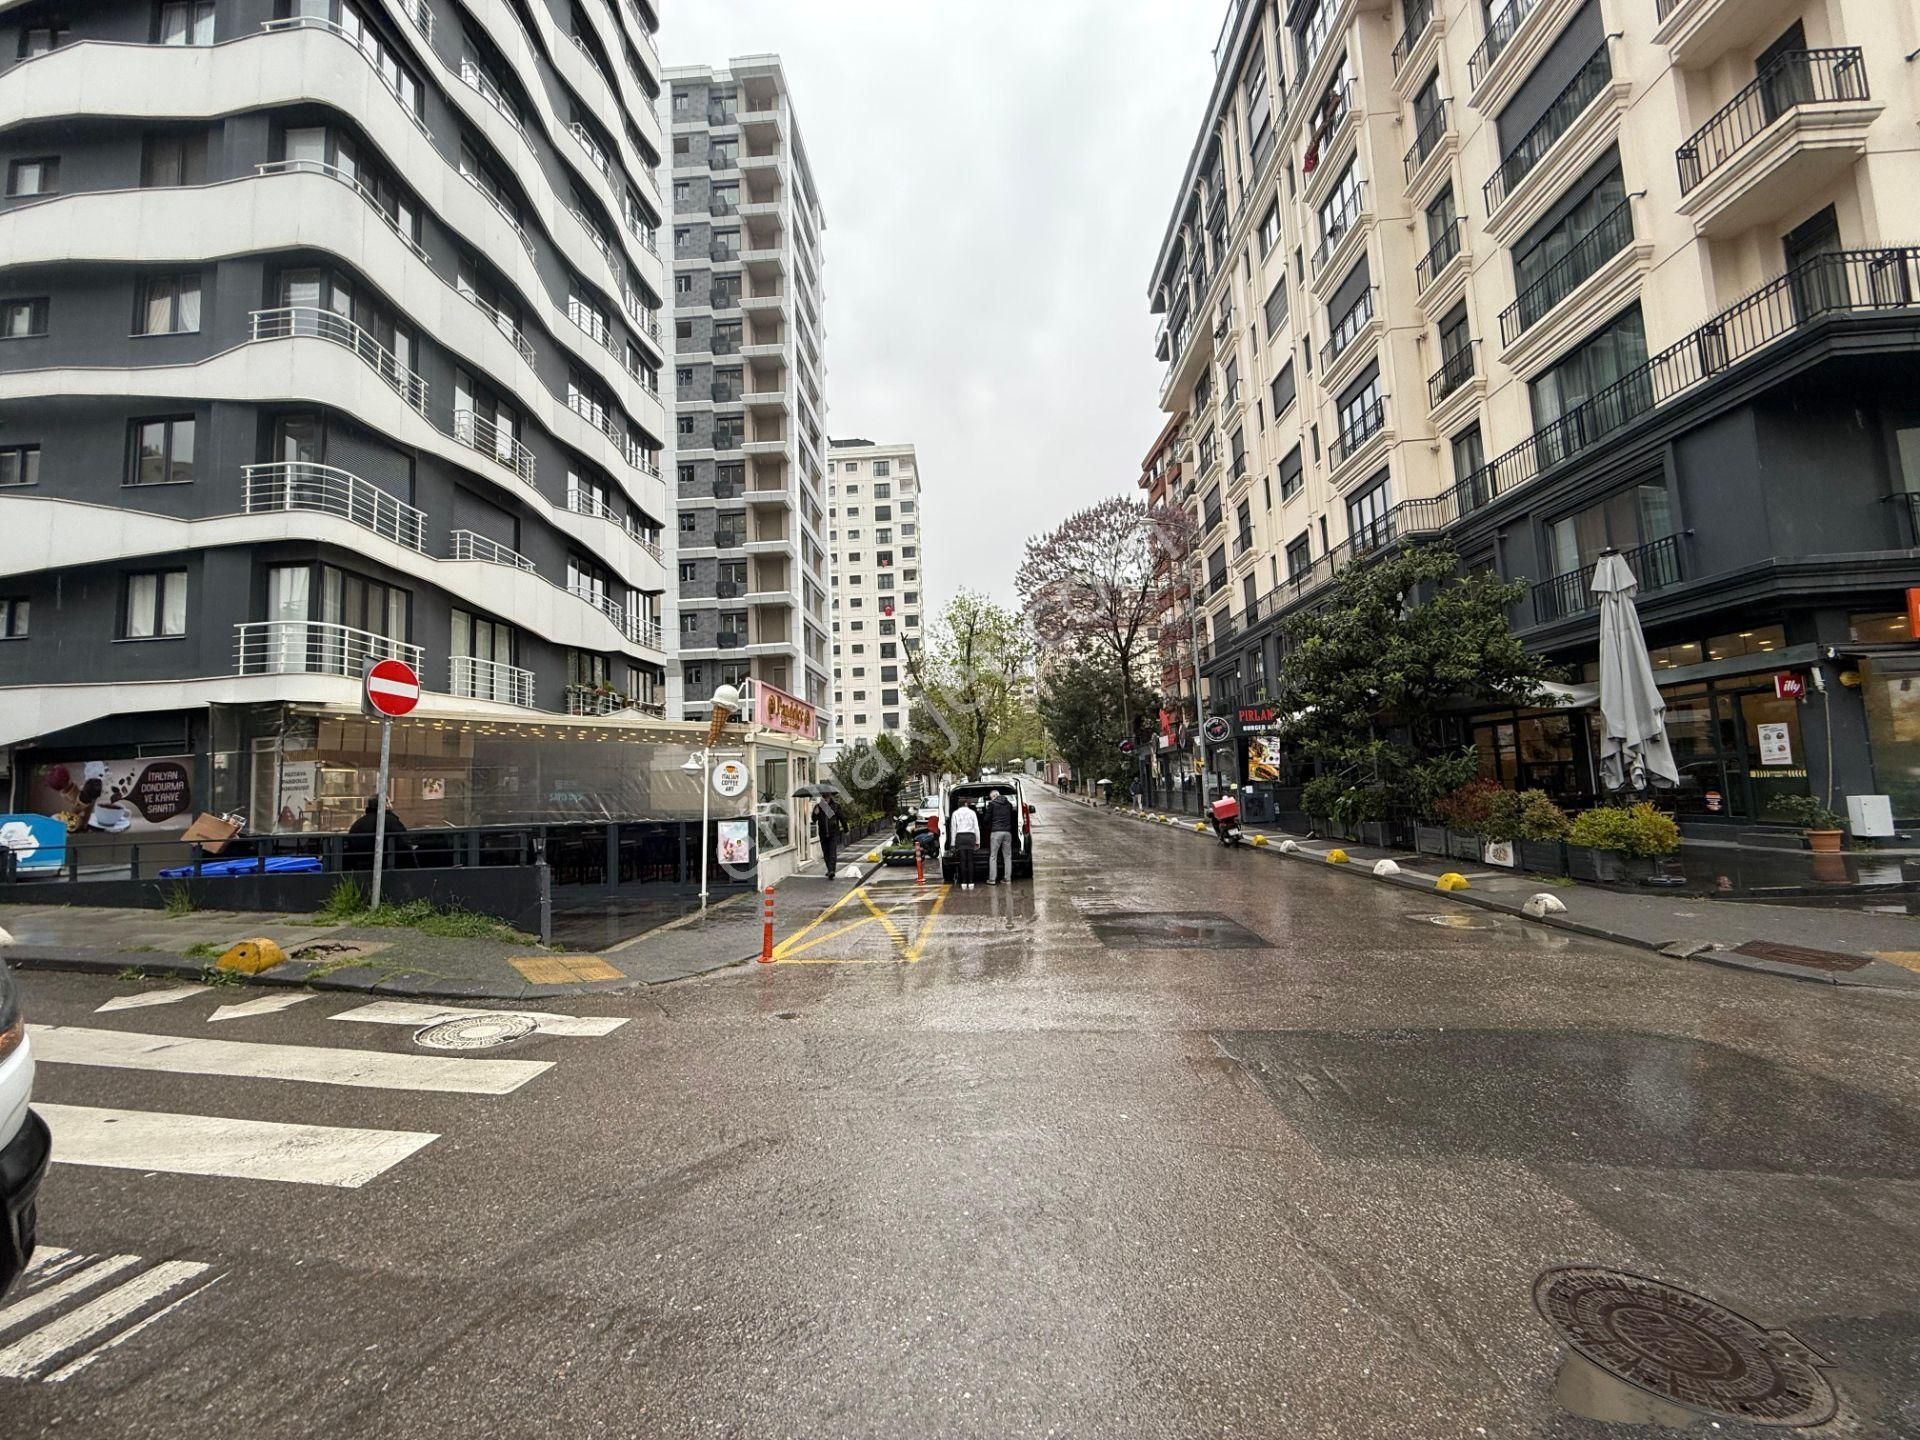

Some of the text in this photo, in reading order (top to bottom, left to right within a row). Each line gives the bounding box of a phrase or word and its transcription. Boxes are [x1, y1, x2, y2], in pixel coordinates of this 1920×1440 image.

[1783, 680, 1801, 694] illy
[141, 782, 184, 792] DONDURMA
[143, 792, 181, 803] VE KAHVE
[147, 803, 176, 814] SANATI
